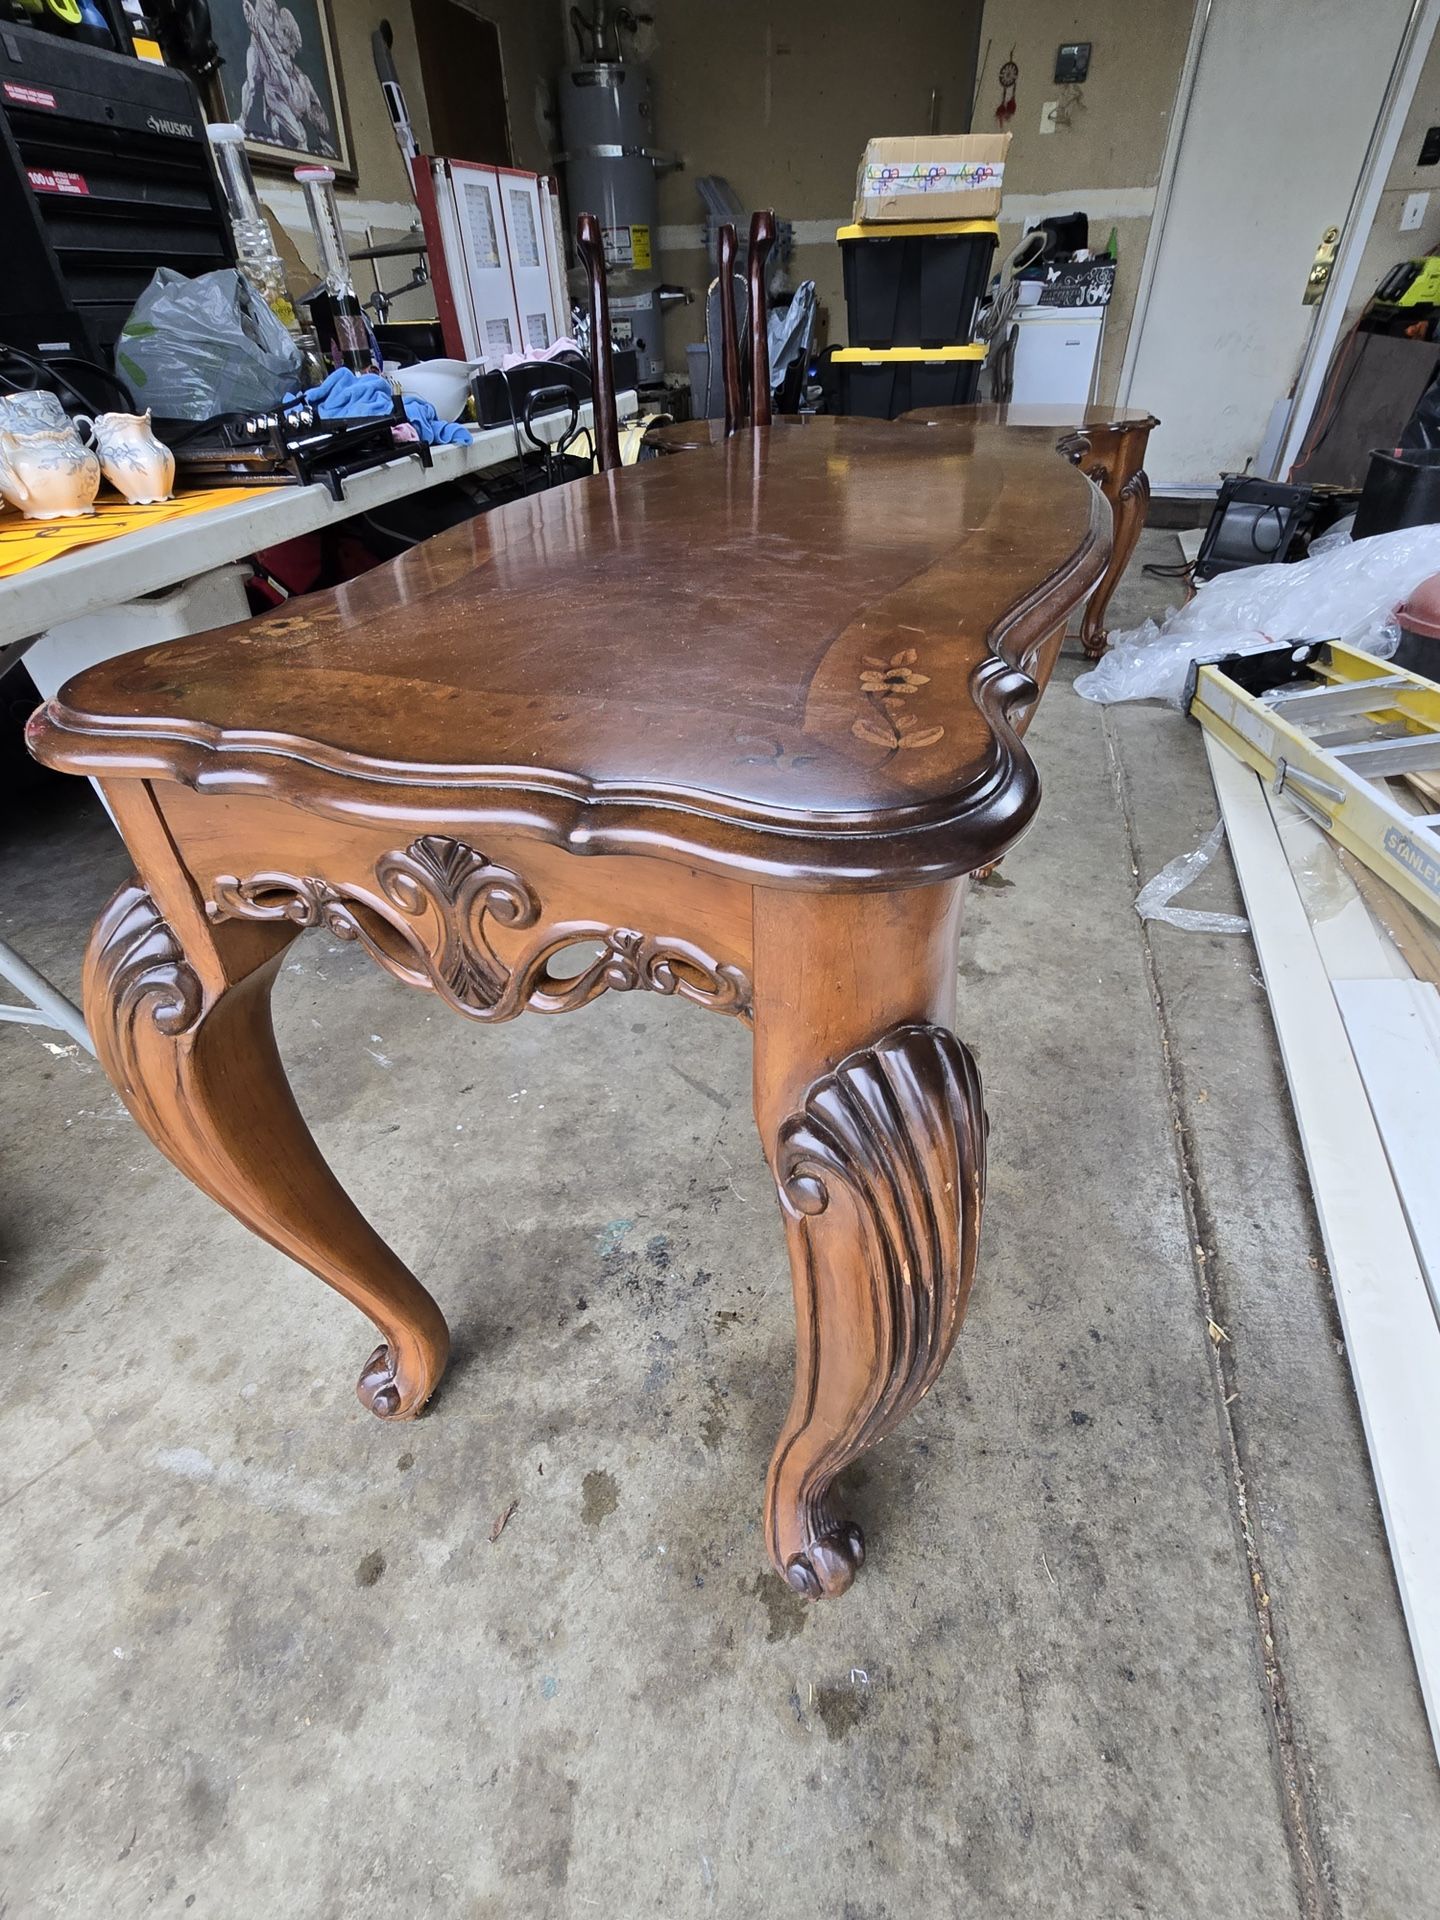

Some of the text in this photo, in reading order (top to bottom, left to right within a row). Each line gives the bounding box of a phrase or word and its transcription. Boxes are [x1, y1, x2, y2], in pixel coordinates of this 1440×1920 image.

[159, 119, 194, 137] HUSKY
[27, 172, 46, 185] 100
[1388, 834, 1440, 886] STANLEY
